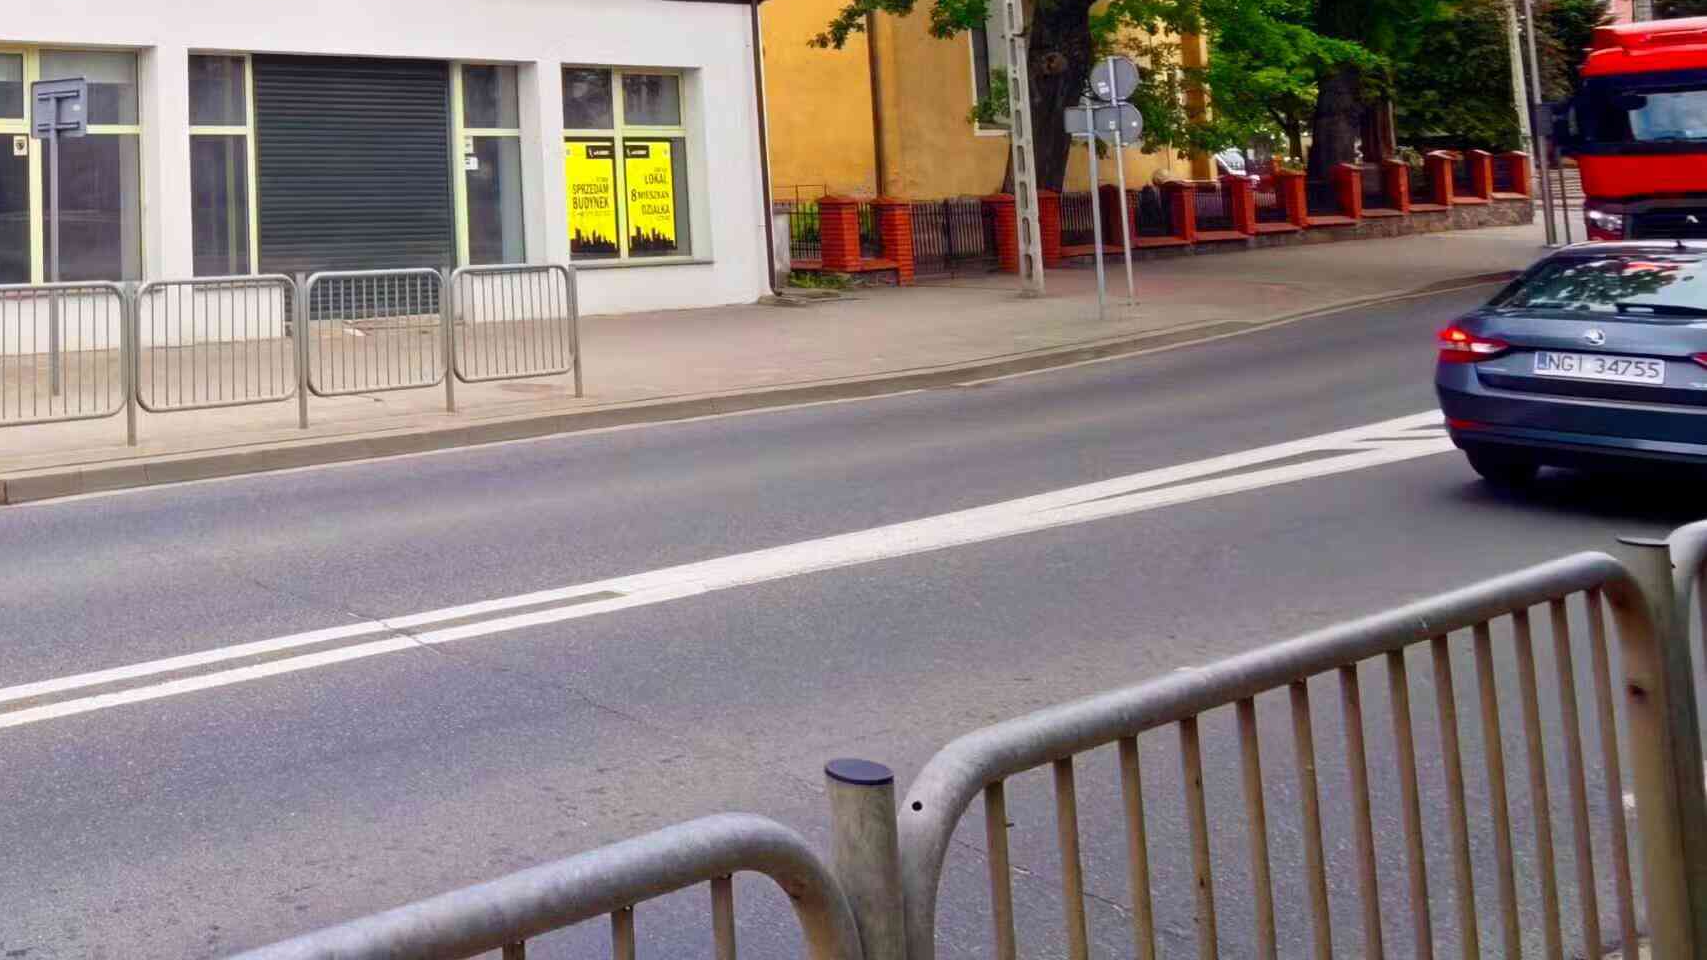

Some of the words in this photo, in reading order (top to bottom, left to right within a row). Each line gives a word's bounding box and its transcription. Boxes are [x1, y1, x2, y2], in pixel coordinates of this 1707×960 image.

[573, 183, 609, 194] SPRZEDAM
[573, 195, 609, 209] BUDYNEK
[1548, 355, 1583, 372] NGI
[1594, 358, 1660, 378] 34755
